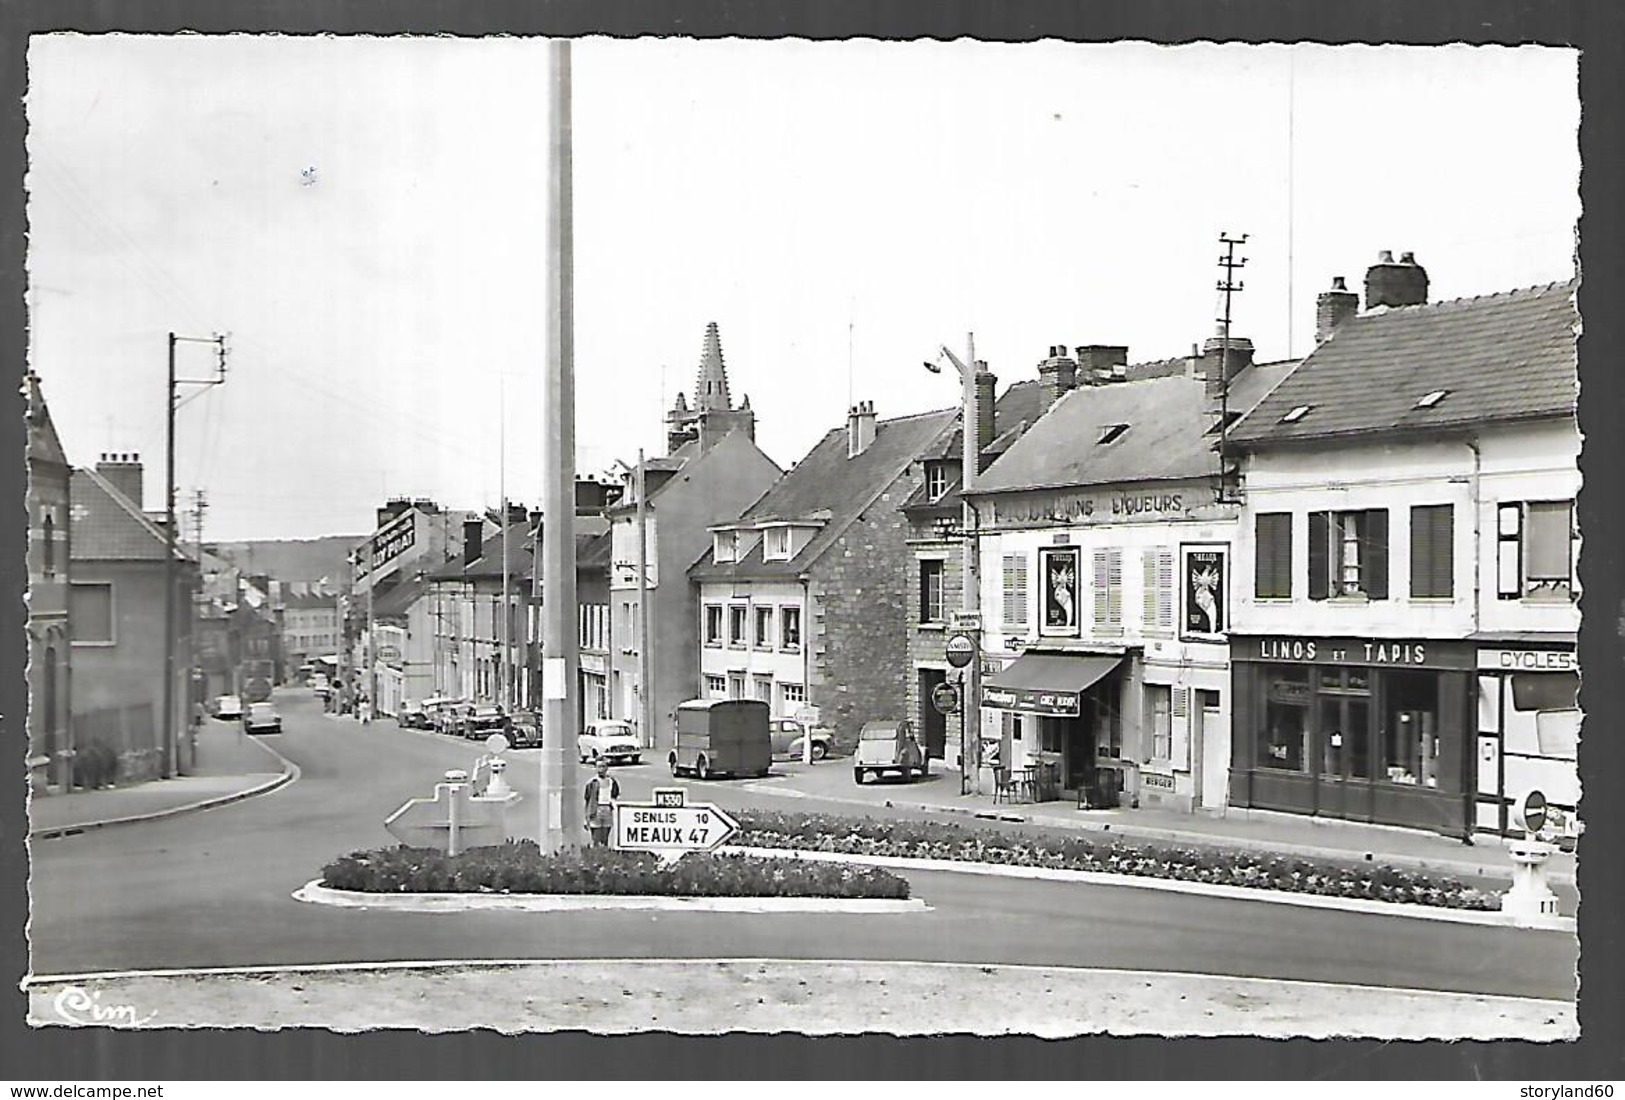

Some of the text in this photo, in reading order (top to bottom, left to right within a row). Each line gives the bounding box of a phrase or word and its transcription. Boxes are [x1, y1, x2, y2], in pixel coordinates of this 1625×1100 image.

[1112, 495, 1182, 516] LIQUEURS
[1260, 640, 1425, 663] LINOS ET TAPIS
[1500, 652, 1570, 669] CYCLES
[633, 812, 709, 824] SENLIS 10
[626, 827, 709, 844] MEAUX 47
